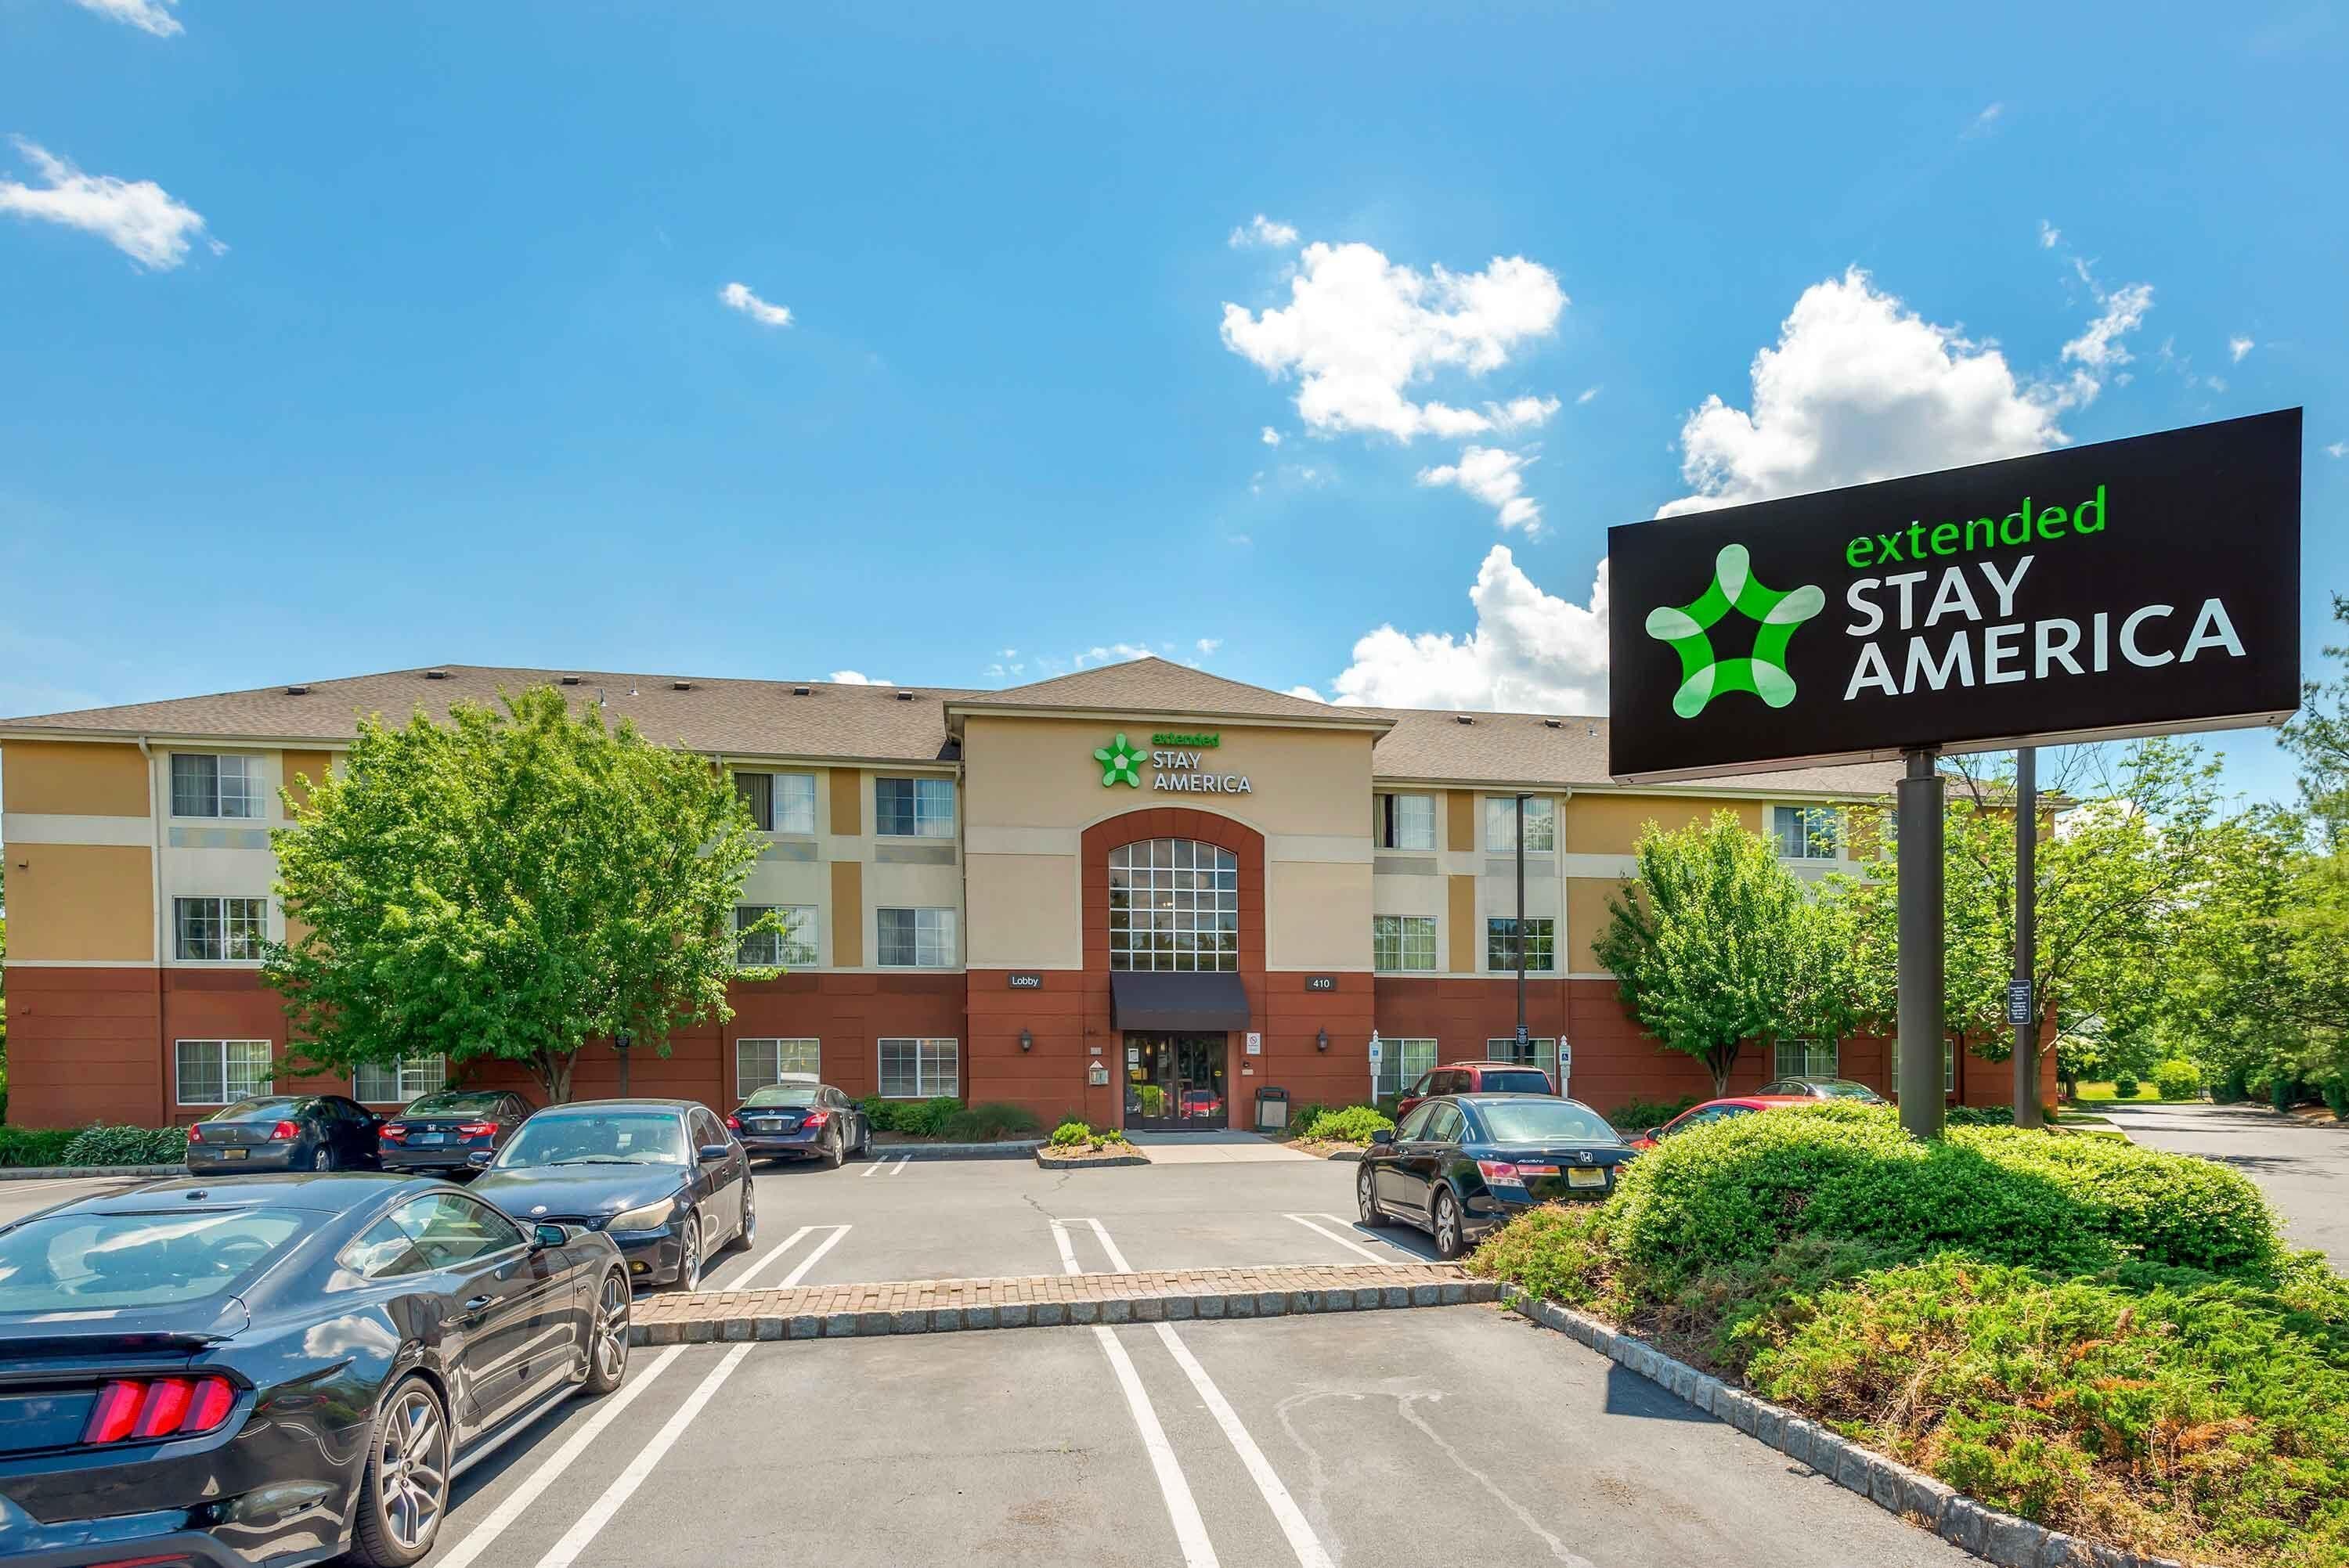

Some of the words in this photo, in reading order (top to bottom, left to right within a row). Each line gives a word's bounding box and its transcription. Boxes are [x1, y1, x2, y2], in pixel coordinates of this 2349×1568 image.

[1846, 484, 2106, 568] extended
[1845, 555, 2036, 637] STAY
[1843, 597, 2247, 701] AMERICA
[1153, 733, 1220, 747] extended
[1153, 751, 1202, 770] STAY
[1153, 773, 1252, 793] AMERICA
[1012, 976, 1038, 987] Lobby
[1313, 979, 1330, 988] 410
